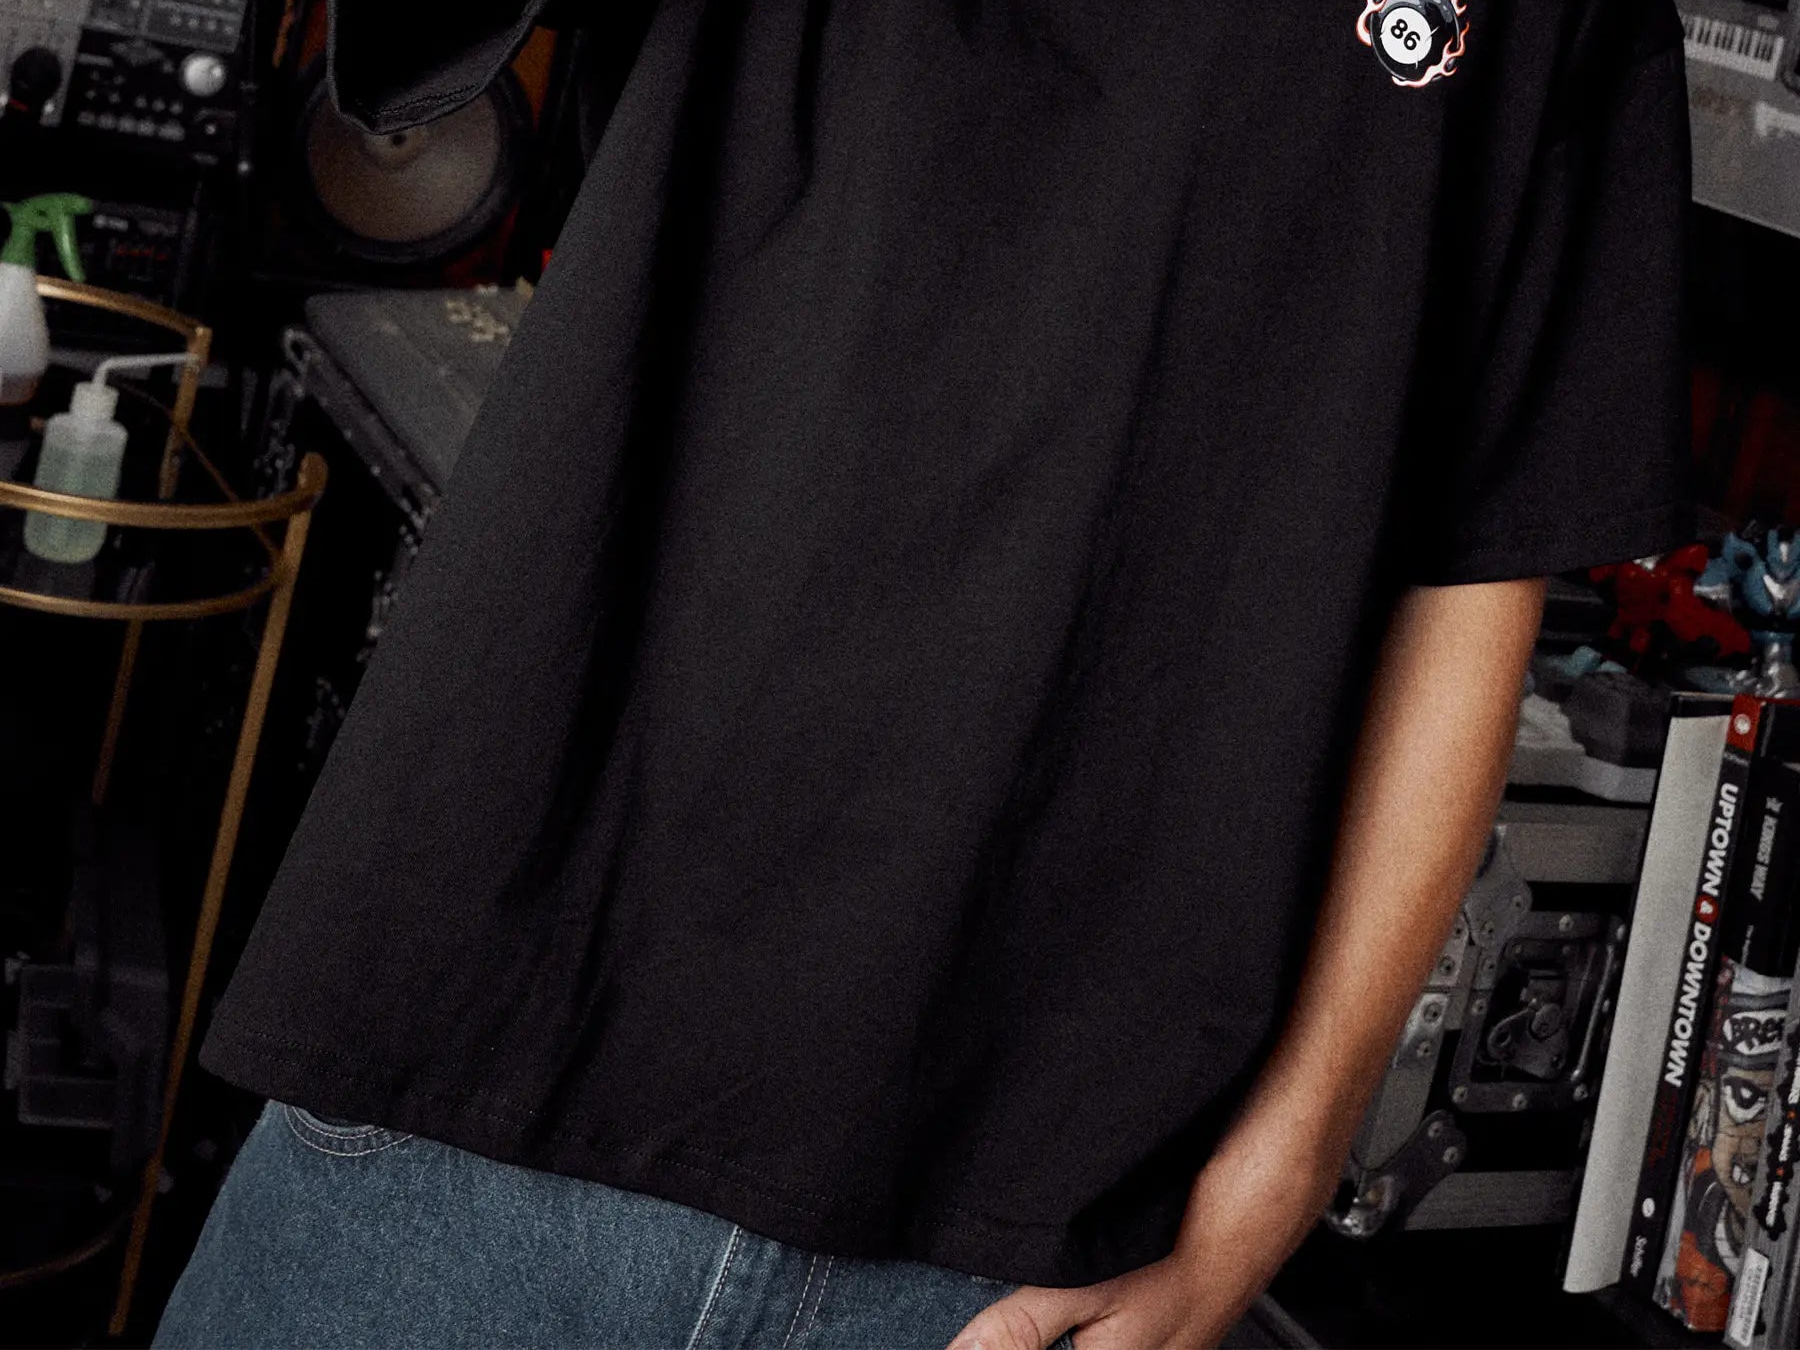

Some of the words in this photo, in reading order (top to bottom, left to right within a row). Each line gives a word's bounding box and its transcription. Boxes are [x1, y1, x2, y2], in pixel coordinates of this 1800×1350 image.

[1390, 18, 1421, 51] 86
[1702, 782, 1739, 897] UPTOWN
[1699, 900, 1714, 915] &
[1664, 921, 1712, 1087] DOWNTOWN
